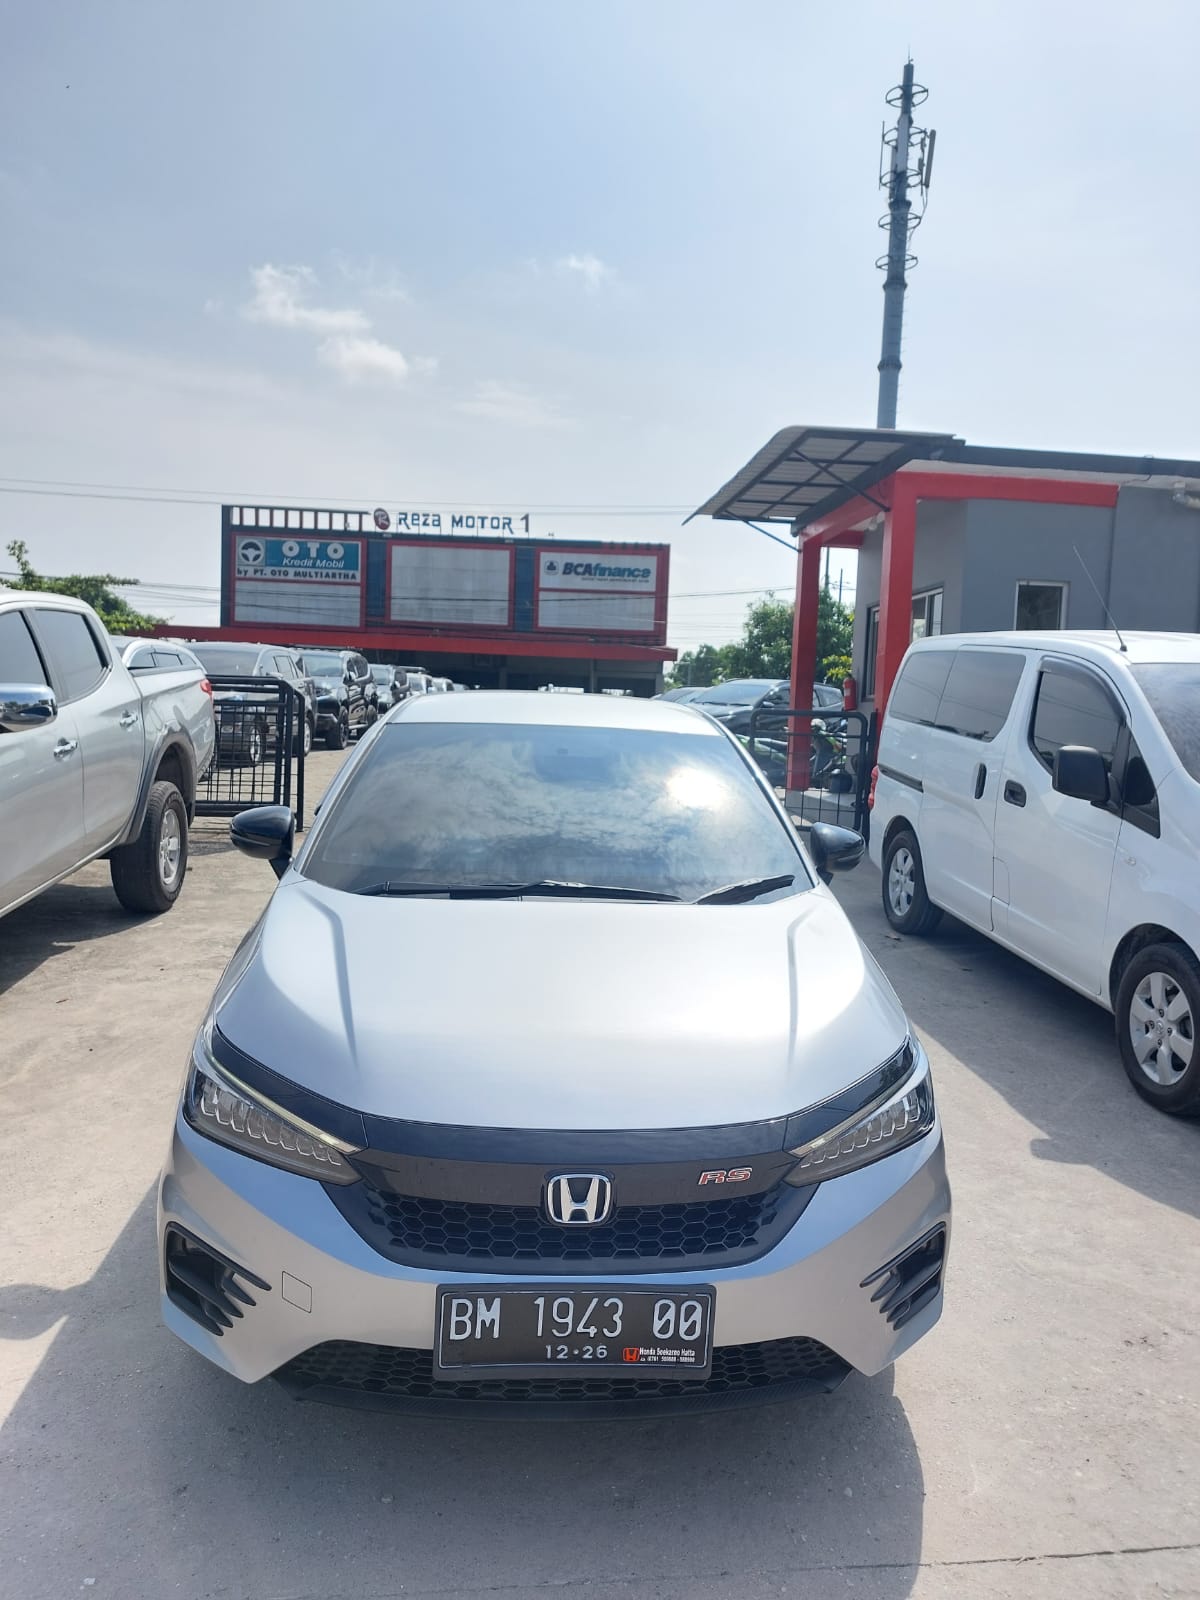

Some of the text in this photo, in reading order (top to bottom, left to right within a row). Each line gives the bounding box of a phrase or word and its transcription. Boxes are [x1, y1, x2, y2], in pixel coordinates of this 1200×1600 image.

[451, 513, 514, 535] MOTOR
[519, 512, 530, 533] 1
[282, 540, 345, 559] OTO
[282, 557, 345, 569] Kredit Mobil
[236, 567, 358, 580] by PT. OTO MULTIARTHA
[698, 1167, 753, 1185] RS
[449, 1297, 501, 1341] BM
[533, 1296, 624, 1339] 1943
[639, 1347, 656, 1355] Honda
[681, 1348, 696, 1356] Hatta
